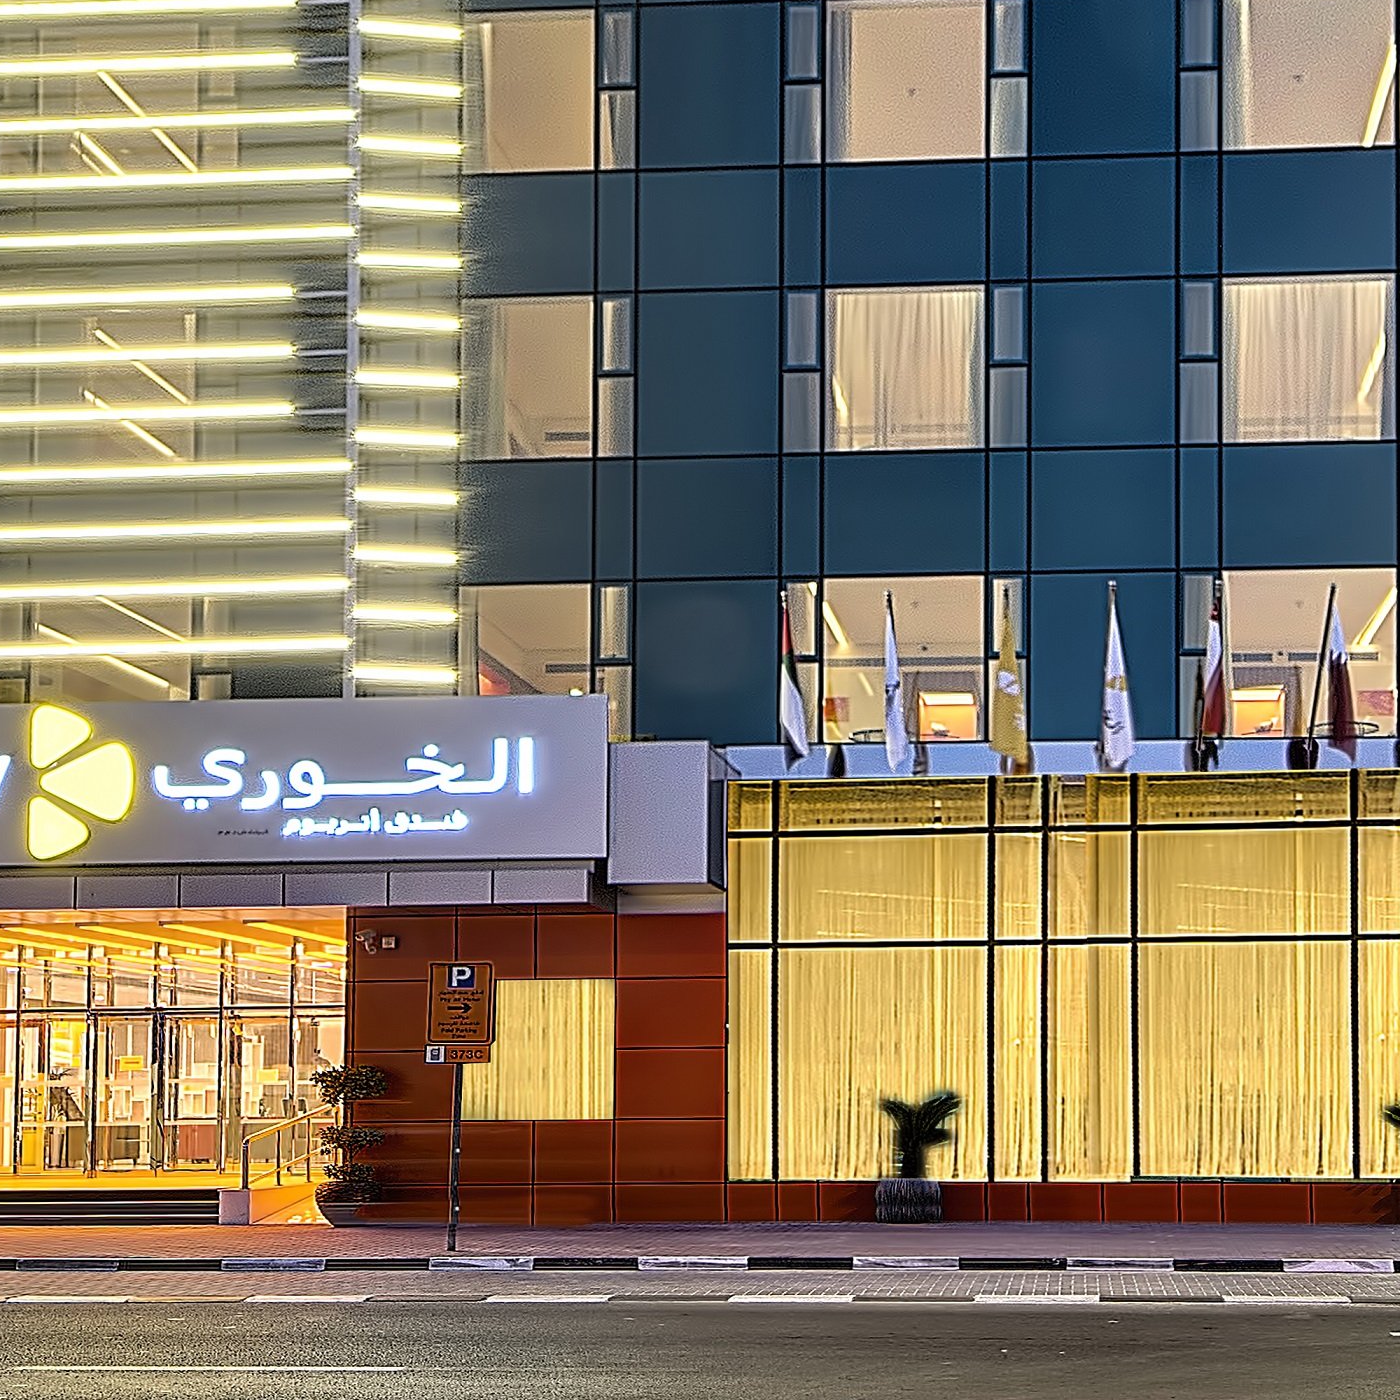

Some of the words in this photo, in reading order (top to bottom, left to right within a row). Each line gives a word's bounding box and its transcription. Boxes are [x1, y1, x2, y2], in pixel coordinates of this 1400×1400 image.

[153, 736, 534, 811] الخوري
[383, 808, 469, 834] فندق
[451, 966, 472, 987] P
[450, 1049, 484, 1060] 373C
